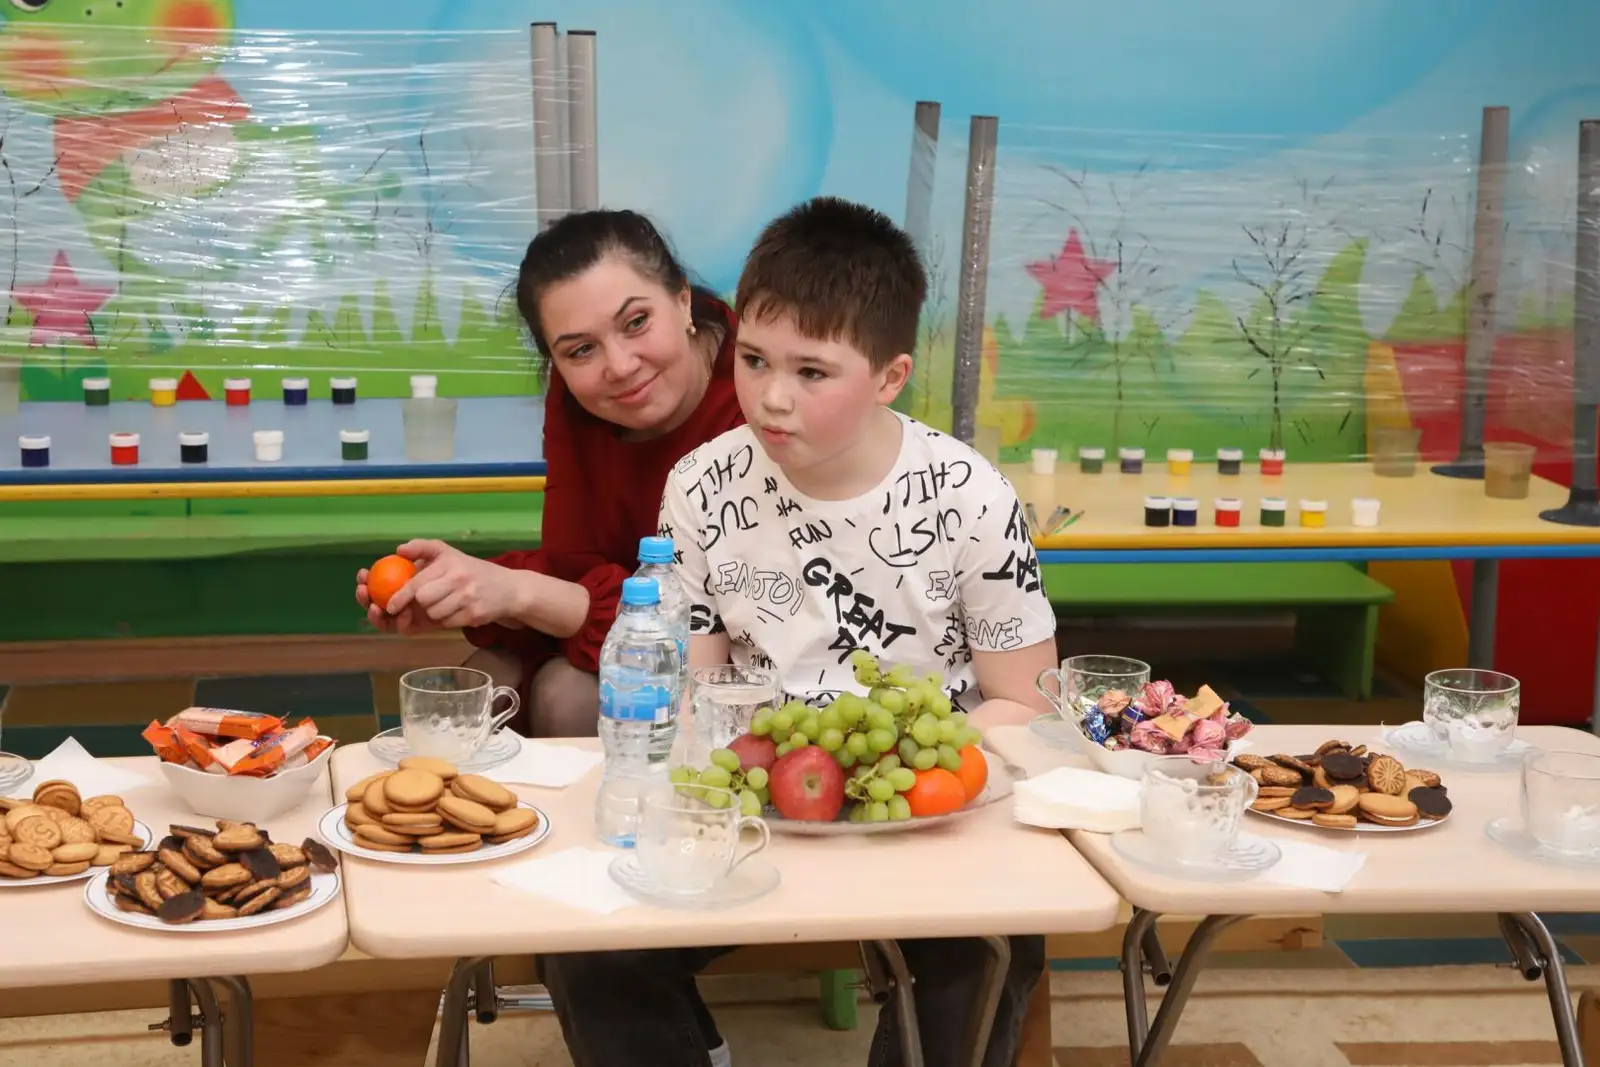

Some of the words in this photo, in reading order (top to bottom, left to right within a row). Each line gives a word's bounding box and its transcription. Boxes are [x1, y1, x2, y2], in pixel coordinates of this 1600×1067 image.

[789, 519, 832, 550] FUN
[889, 508, 963, 558] JUST
[802, 557, 916, 649] GREAT
